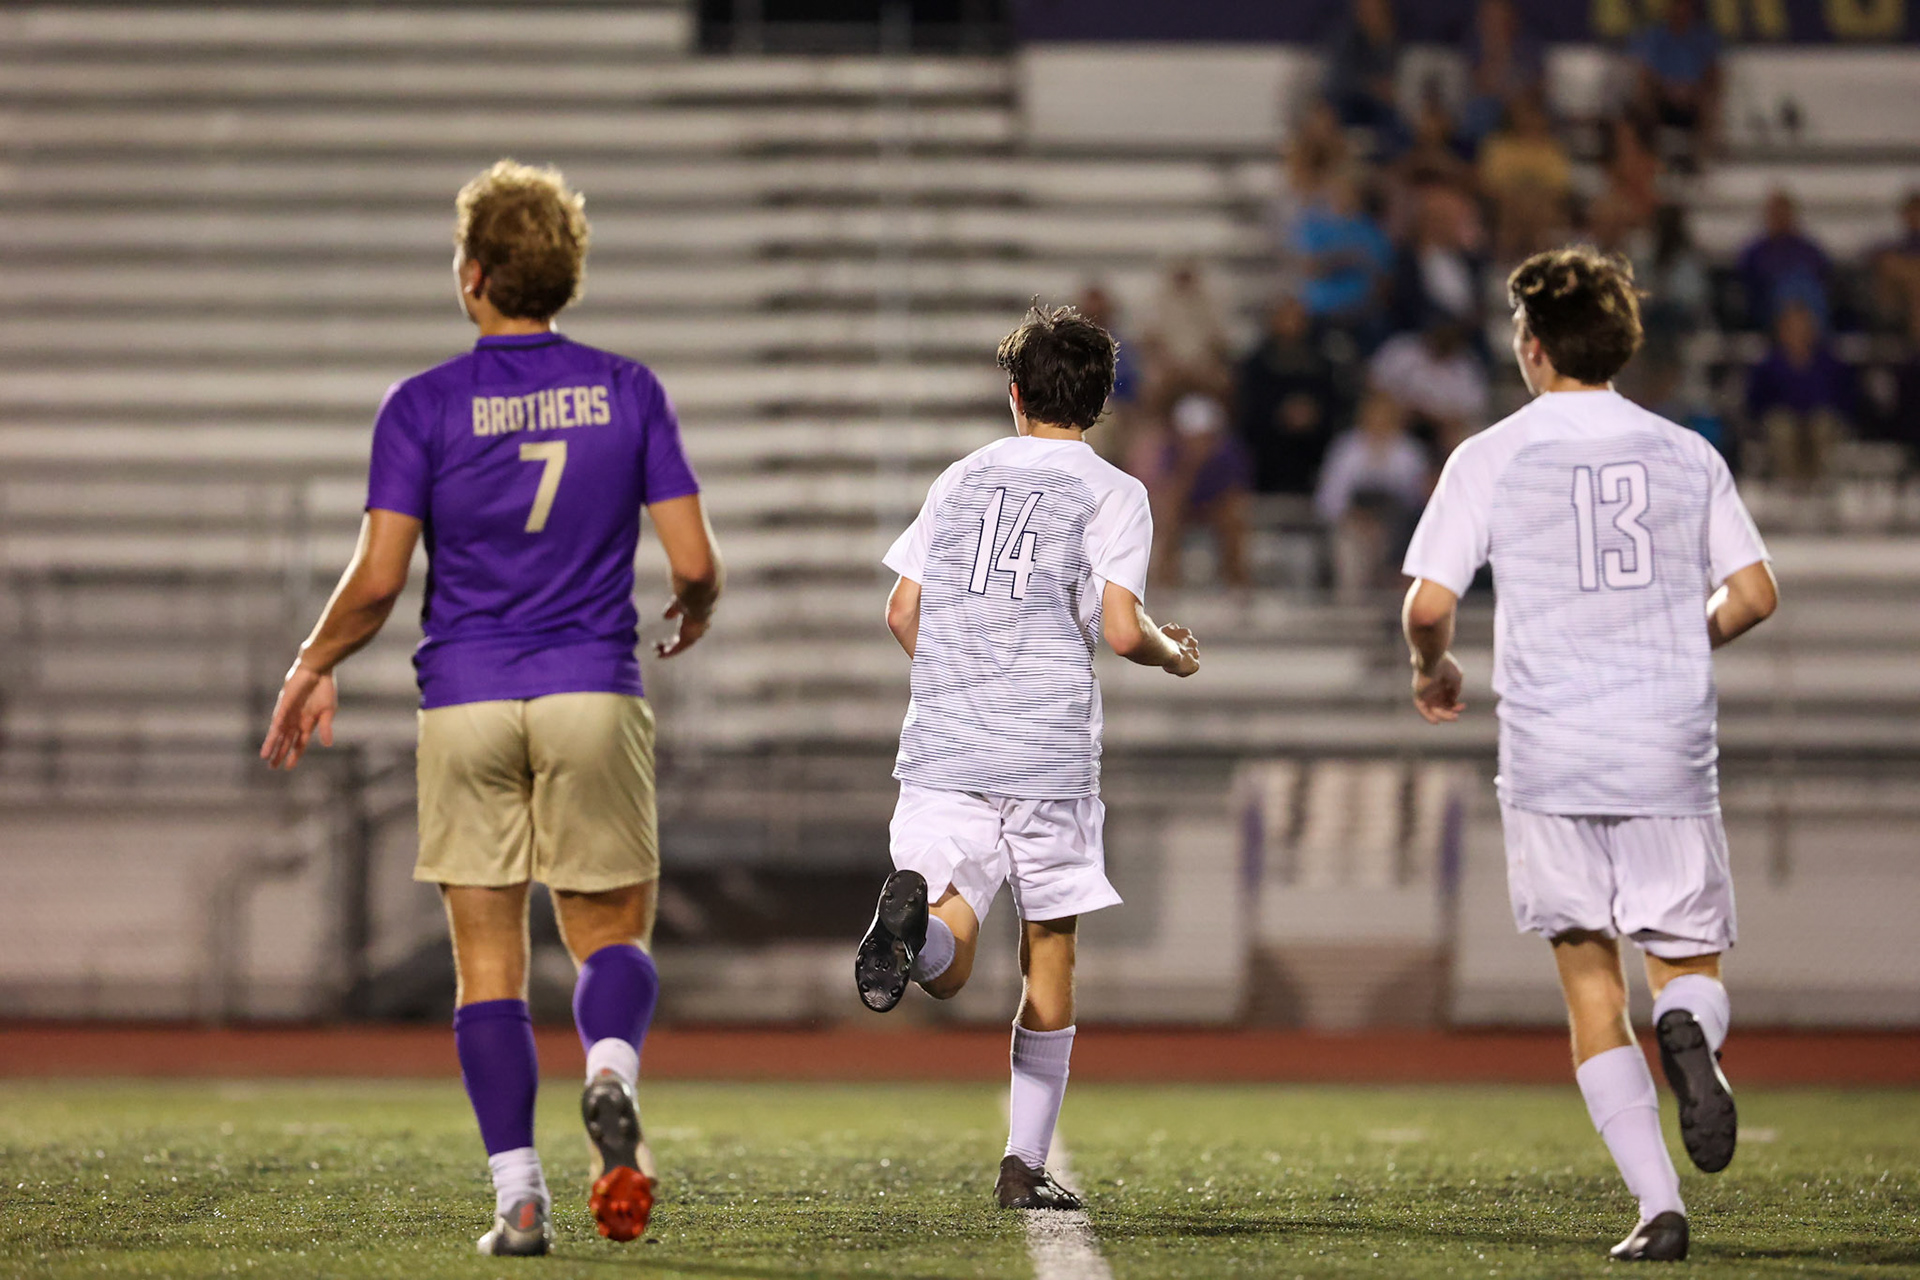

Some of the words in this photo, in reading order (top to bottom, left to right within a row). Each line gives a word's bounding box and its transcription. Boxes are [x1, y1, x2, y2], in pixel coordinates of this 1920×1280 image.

[472, 385, 611, 436] BROTHERS
[519, 440, 567, 533] 7
[1571, 461, 1655, 592] 13
[968, 487, 1043, 600] 14
